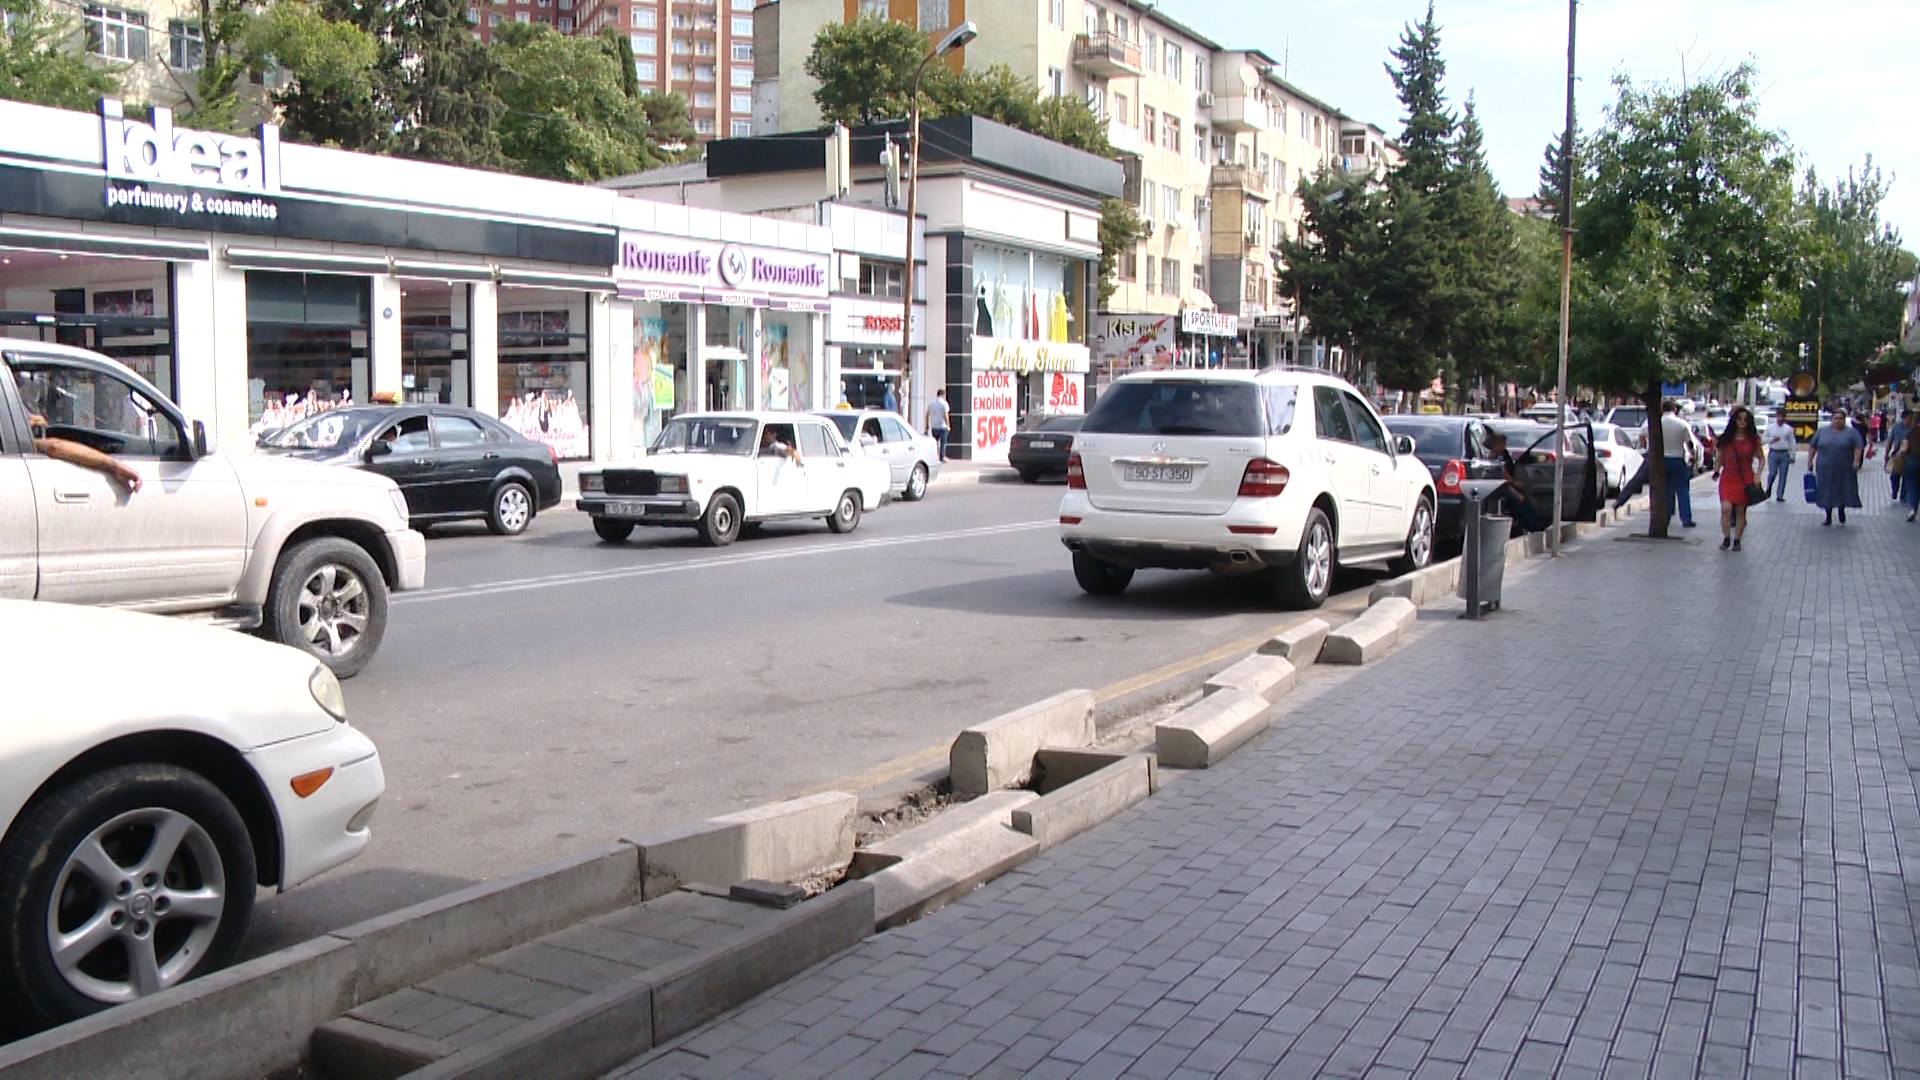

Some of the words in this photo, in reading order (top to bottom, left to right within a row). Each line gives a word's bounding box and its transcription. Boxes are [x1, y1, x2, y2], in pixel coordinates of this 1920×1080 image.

[98, 97, 280, 192] ideal
[107, 186, 188, 214] perfumery
[191, 193, 204, 212] &
[206, 199, 278, 219] cosmetics
[622, 241, 712, 275] Romantic
[751, 256, 826, 286] Romantic
[976, 371, 1010, 389] BÖYÜK
[976, 415, 1008, 450] 50%
